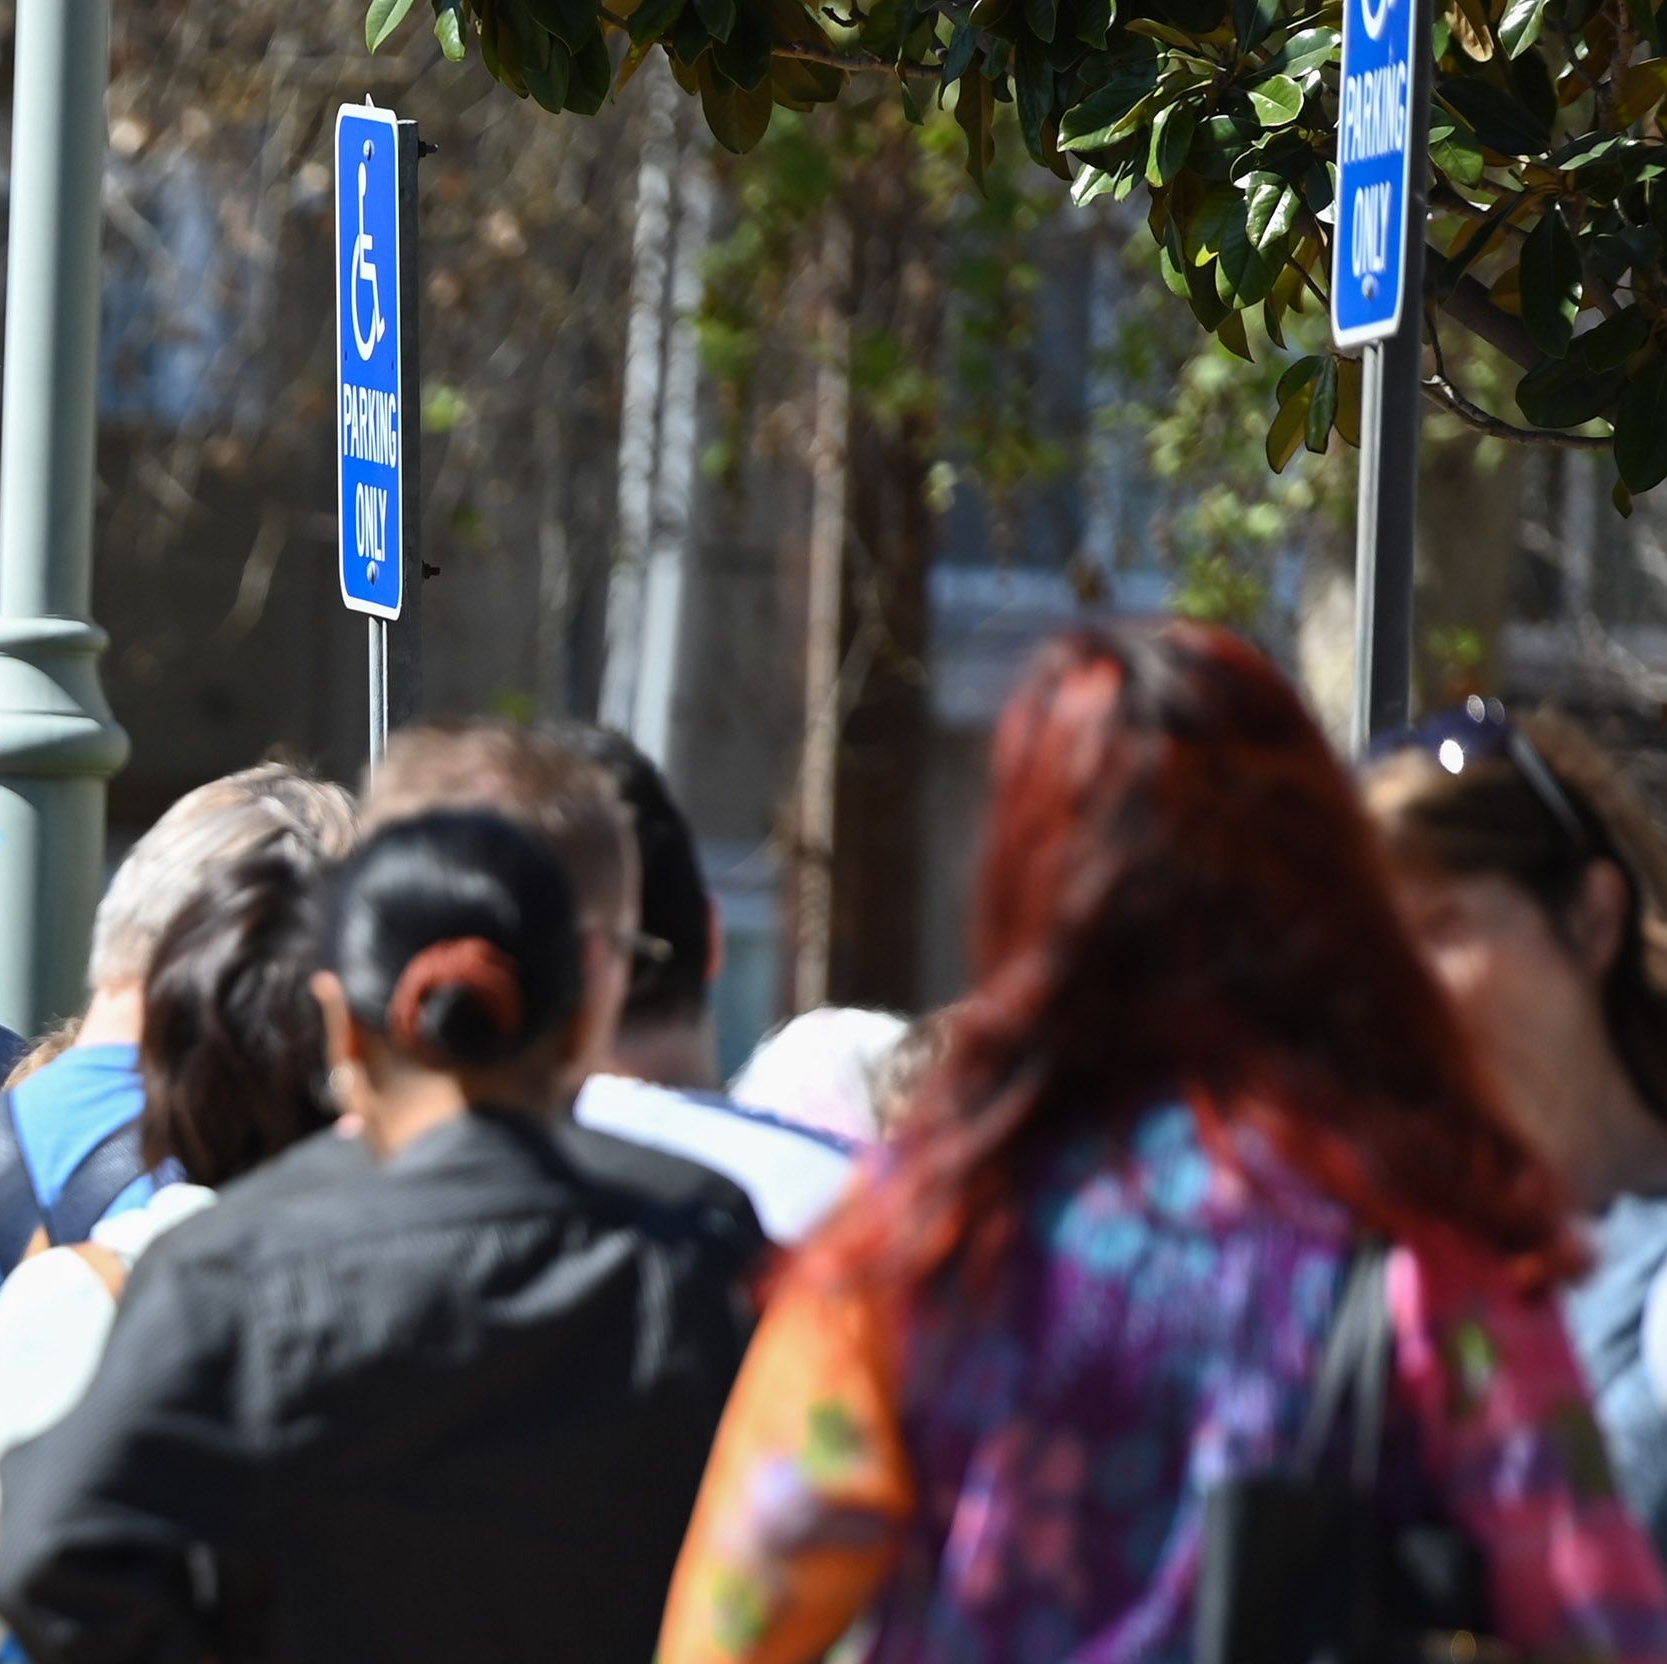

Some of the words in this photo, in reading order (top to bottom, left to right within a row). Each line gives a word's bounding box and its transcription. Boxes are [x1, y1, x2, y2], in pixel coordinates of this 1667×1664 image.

[1343, 60, 1406, 164] PARKING
[1352, 181, 1392, 277] ONLY
[343, 383, 397, 468] PARKING
[355, 482, 388, 562] ONLY
